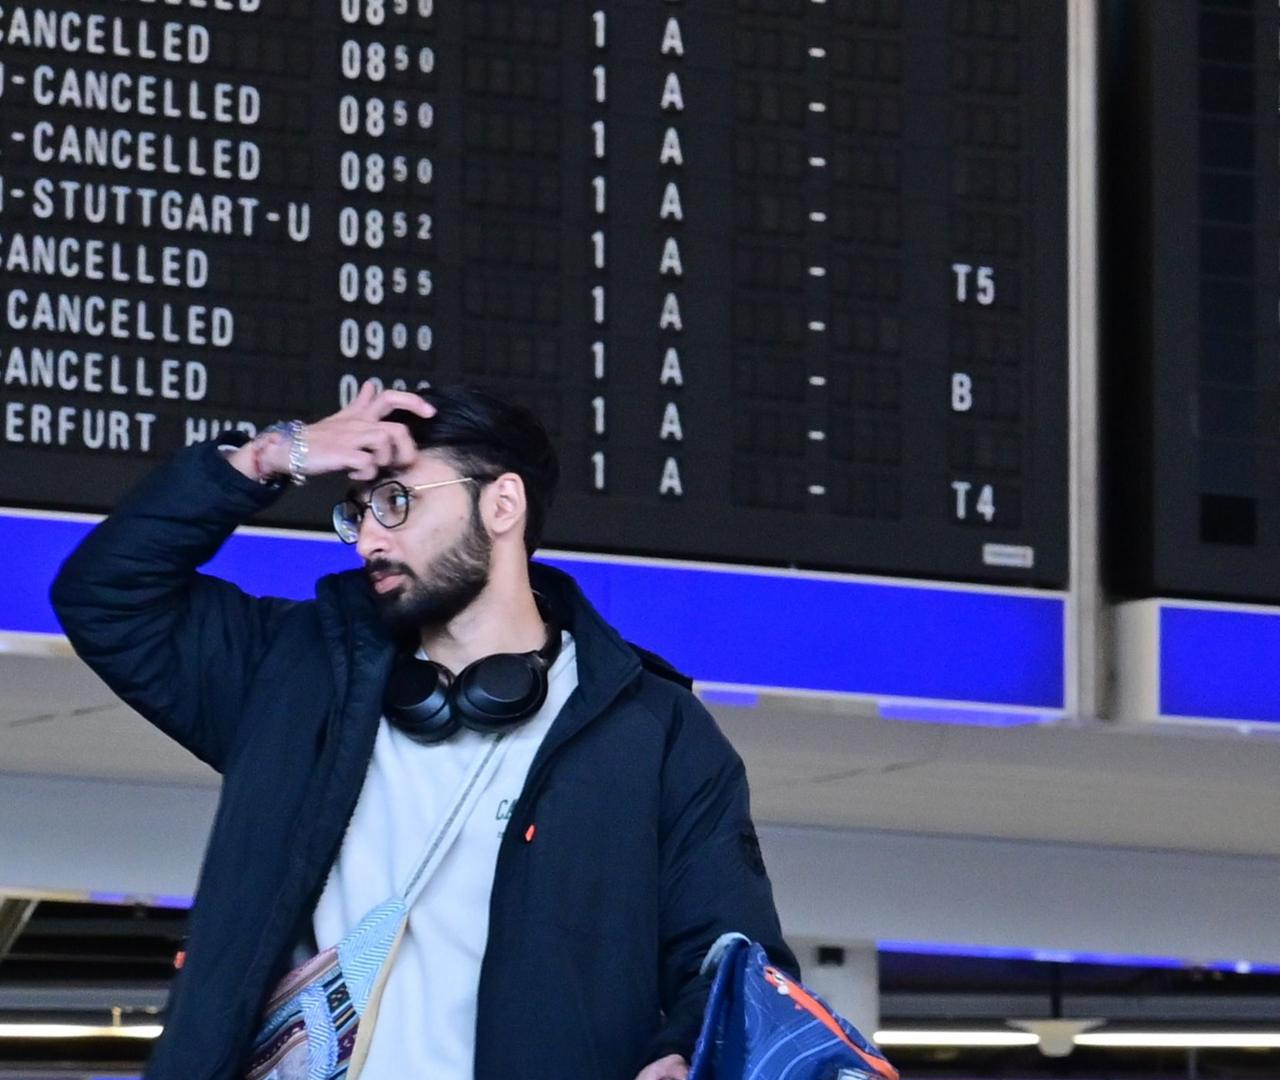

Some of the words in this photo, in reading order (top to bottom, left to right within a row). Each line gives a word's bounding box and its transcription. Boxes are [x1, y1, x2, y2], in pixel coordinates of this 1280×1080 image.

[591, 9, 606, 48] 1
[660, 16, 685, 56] A
[592, 64, 607, 104] 1
[659, 71, 685, 111] A
[591, 119, 606, 159] 1
[659, 126, 684, 166] A
[591, 175, 606, 214] 1
[659, 181, 684, 221] A
[590, 230, 605, 270] 1
[659, 237, 683, 276] A
[951, 262, 996, 306] T5
[591, 285, 605, 324] 1
[658, 292, 684, 331] A
[591, 340, 605, 380] 1
[659, 346, 684, 386] A
[950, 372, 973, 412] B
[591, 395, 606, 435] 1
[659, 401, 684, 441] A
[591, 451, 605, 490] 1
[659, 456, 684, 495] A
[951, 480, 996, 522] T4
